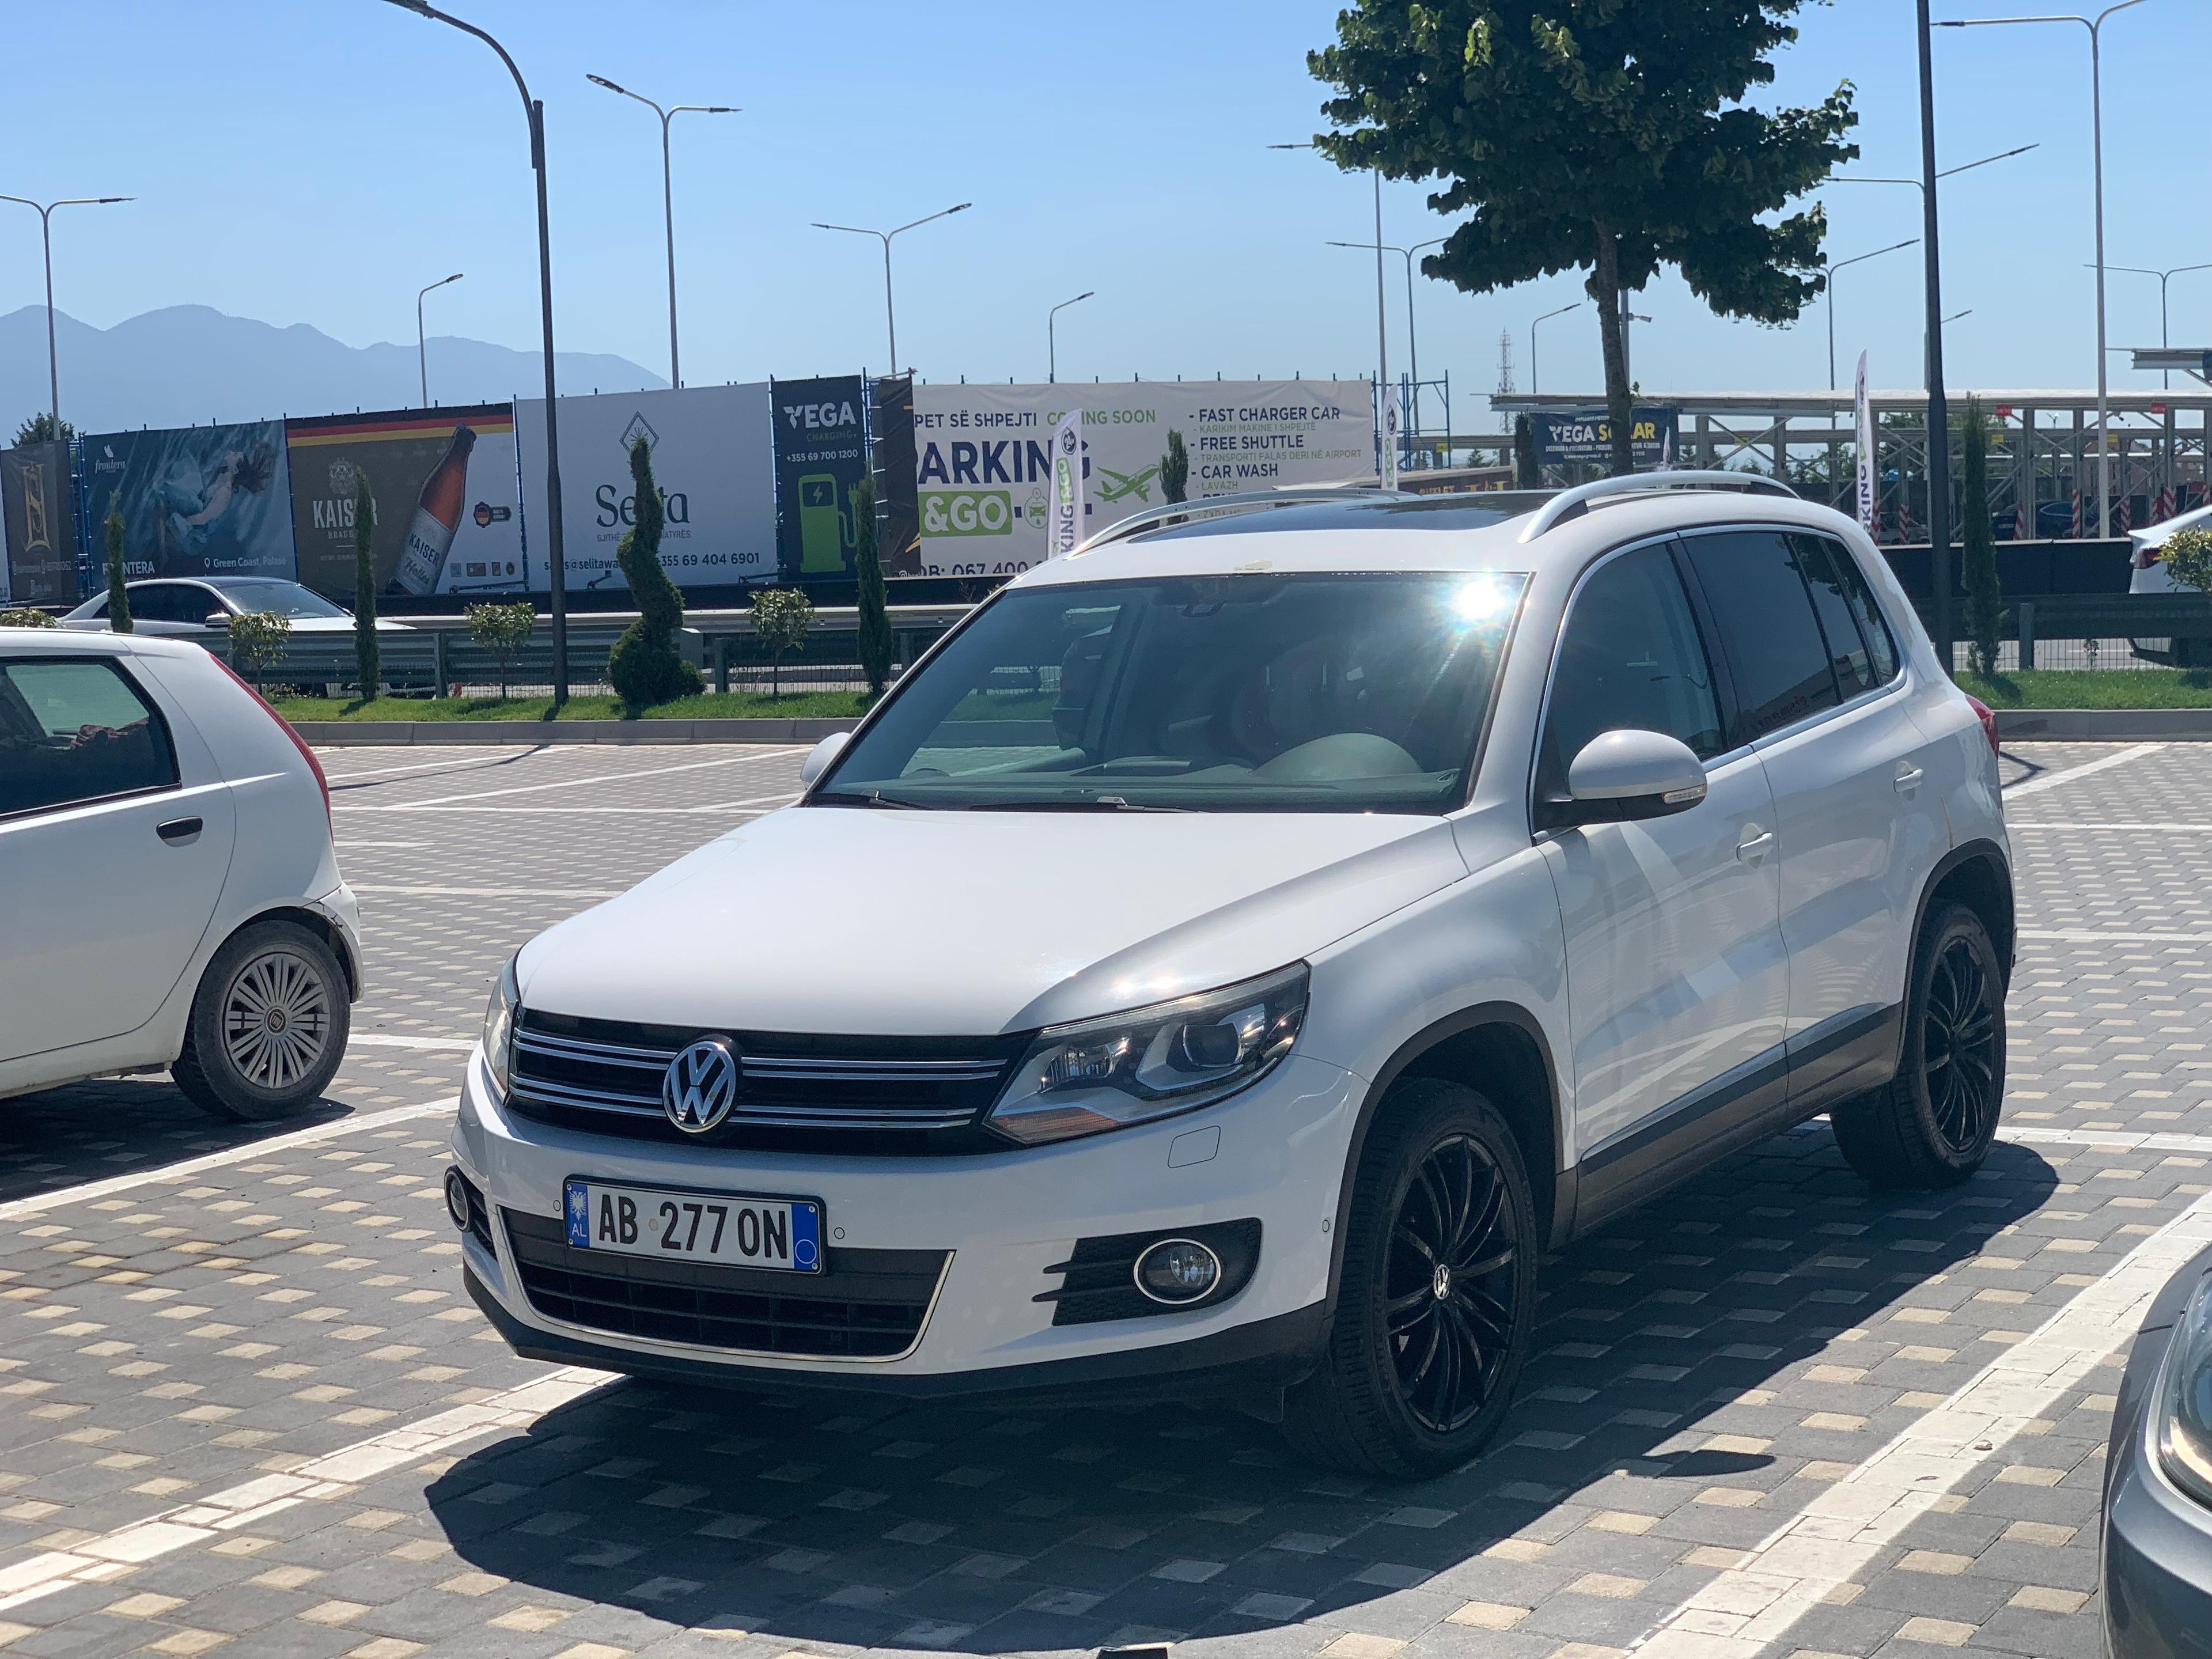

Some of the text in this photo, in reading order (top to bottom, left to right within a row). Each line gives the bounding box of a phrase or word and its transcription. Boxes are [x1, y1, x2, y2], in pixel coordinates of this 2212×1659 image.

[914, 410, 1156, 428] PET SË SHPEJTI CING SOON
[1199, 407, 1340, 422] FAST CHARGER CAR
[1199, 425, 1237, 433] KARIKIM
[1598, 422, 1656, 442] SAR
[1200, 434, 1304, 451] FREE SHUTTLE
[786, 449, 858, 462] +355 69 700 1200
[918, 440, 1090, 484] ARKIN
[1201, 452, 1257, 463] TRANSPORTI
[1259, 451, 1287, 461] FALAS
[1325, 449, 1362, 459] AIRPORT
[1201, 463, 1279, 479] CAR WASH
[1201, 480, 1238, 491] LAVAZH
[313, 498, 378, 529] KAISR
[923, 495, 1007, 532] &GO
[408, 532, 440, 567] KAISER
[213, 558, 236, 568] Green
[682, 554, 698, 566] 69
[702, 553, 727, 566] 404
[730, 552, 760, 565] 6901
[102, 560, 155, 575] FNTERA
[952, 563, 986, 575] 067
[991, 561, 1029, 575] 400
[571, 1223, 587, 1238] AL
[599, 1194, 787, 1260] AB 277 ON
